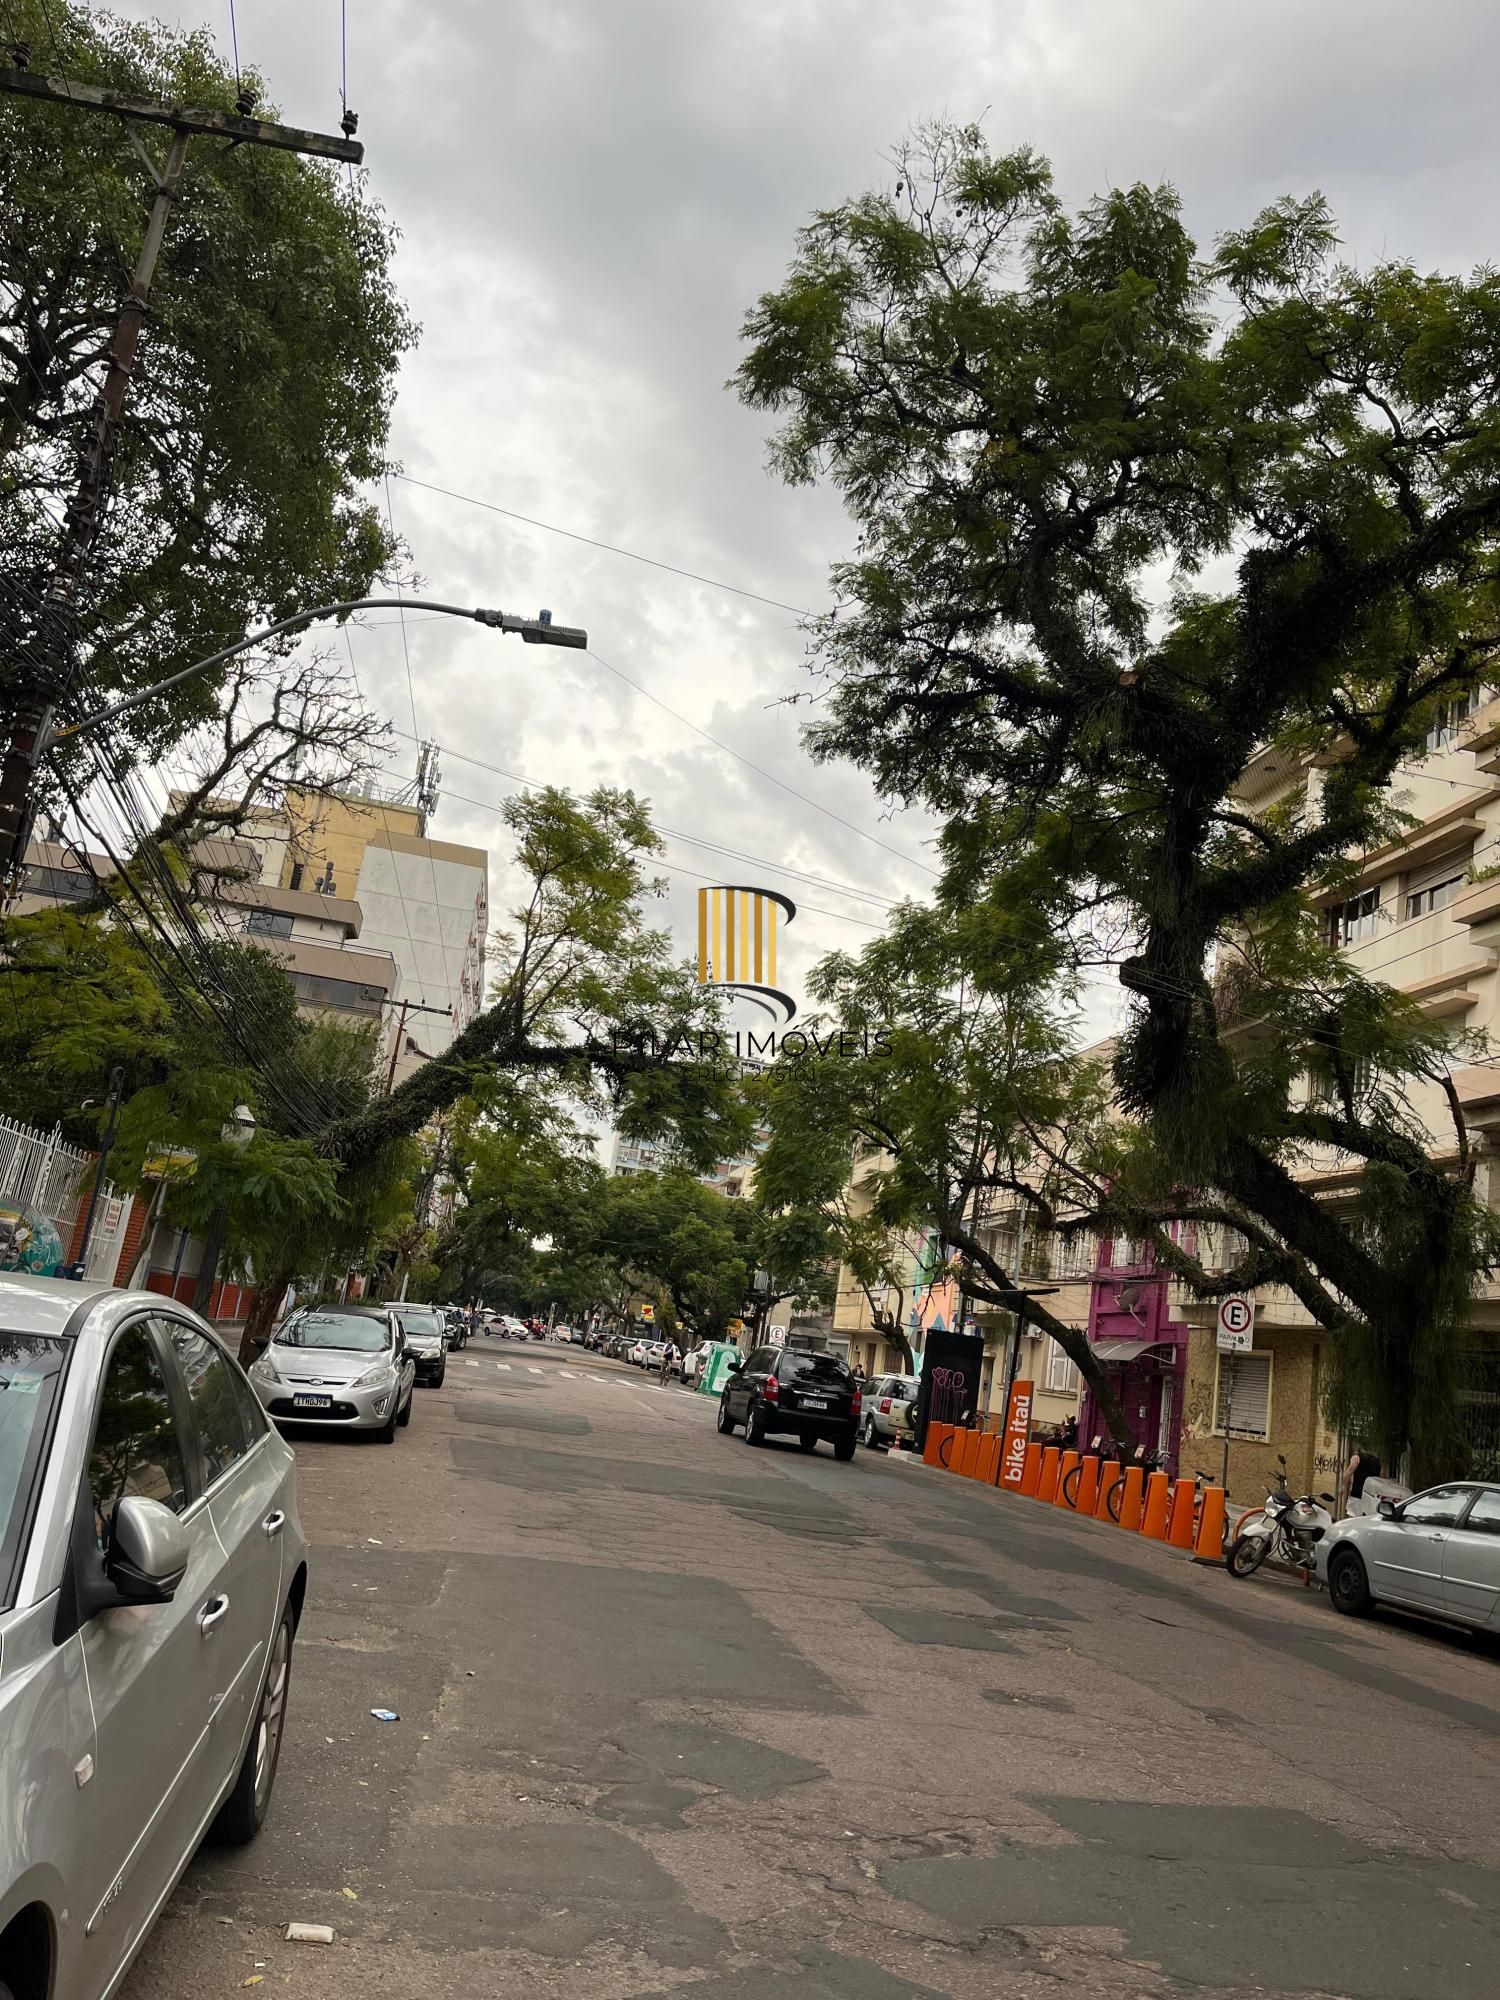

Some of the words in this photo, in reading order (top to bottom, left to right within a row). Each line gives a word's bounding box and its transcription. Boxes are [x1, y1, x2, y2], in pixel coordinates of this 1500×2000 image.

[1230, 1305, 1243, 1326] E
[1009, 1395, 1030, 1433] itaú
[1005, 1438, 1026, 1482] bike
